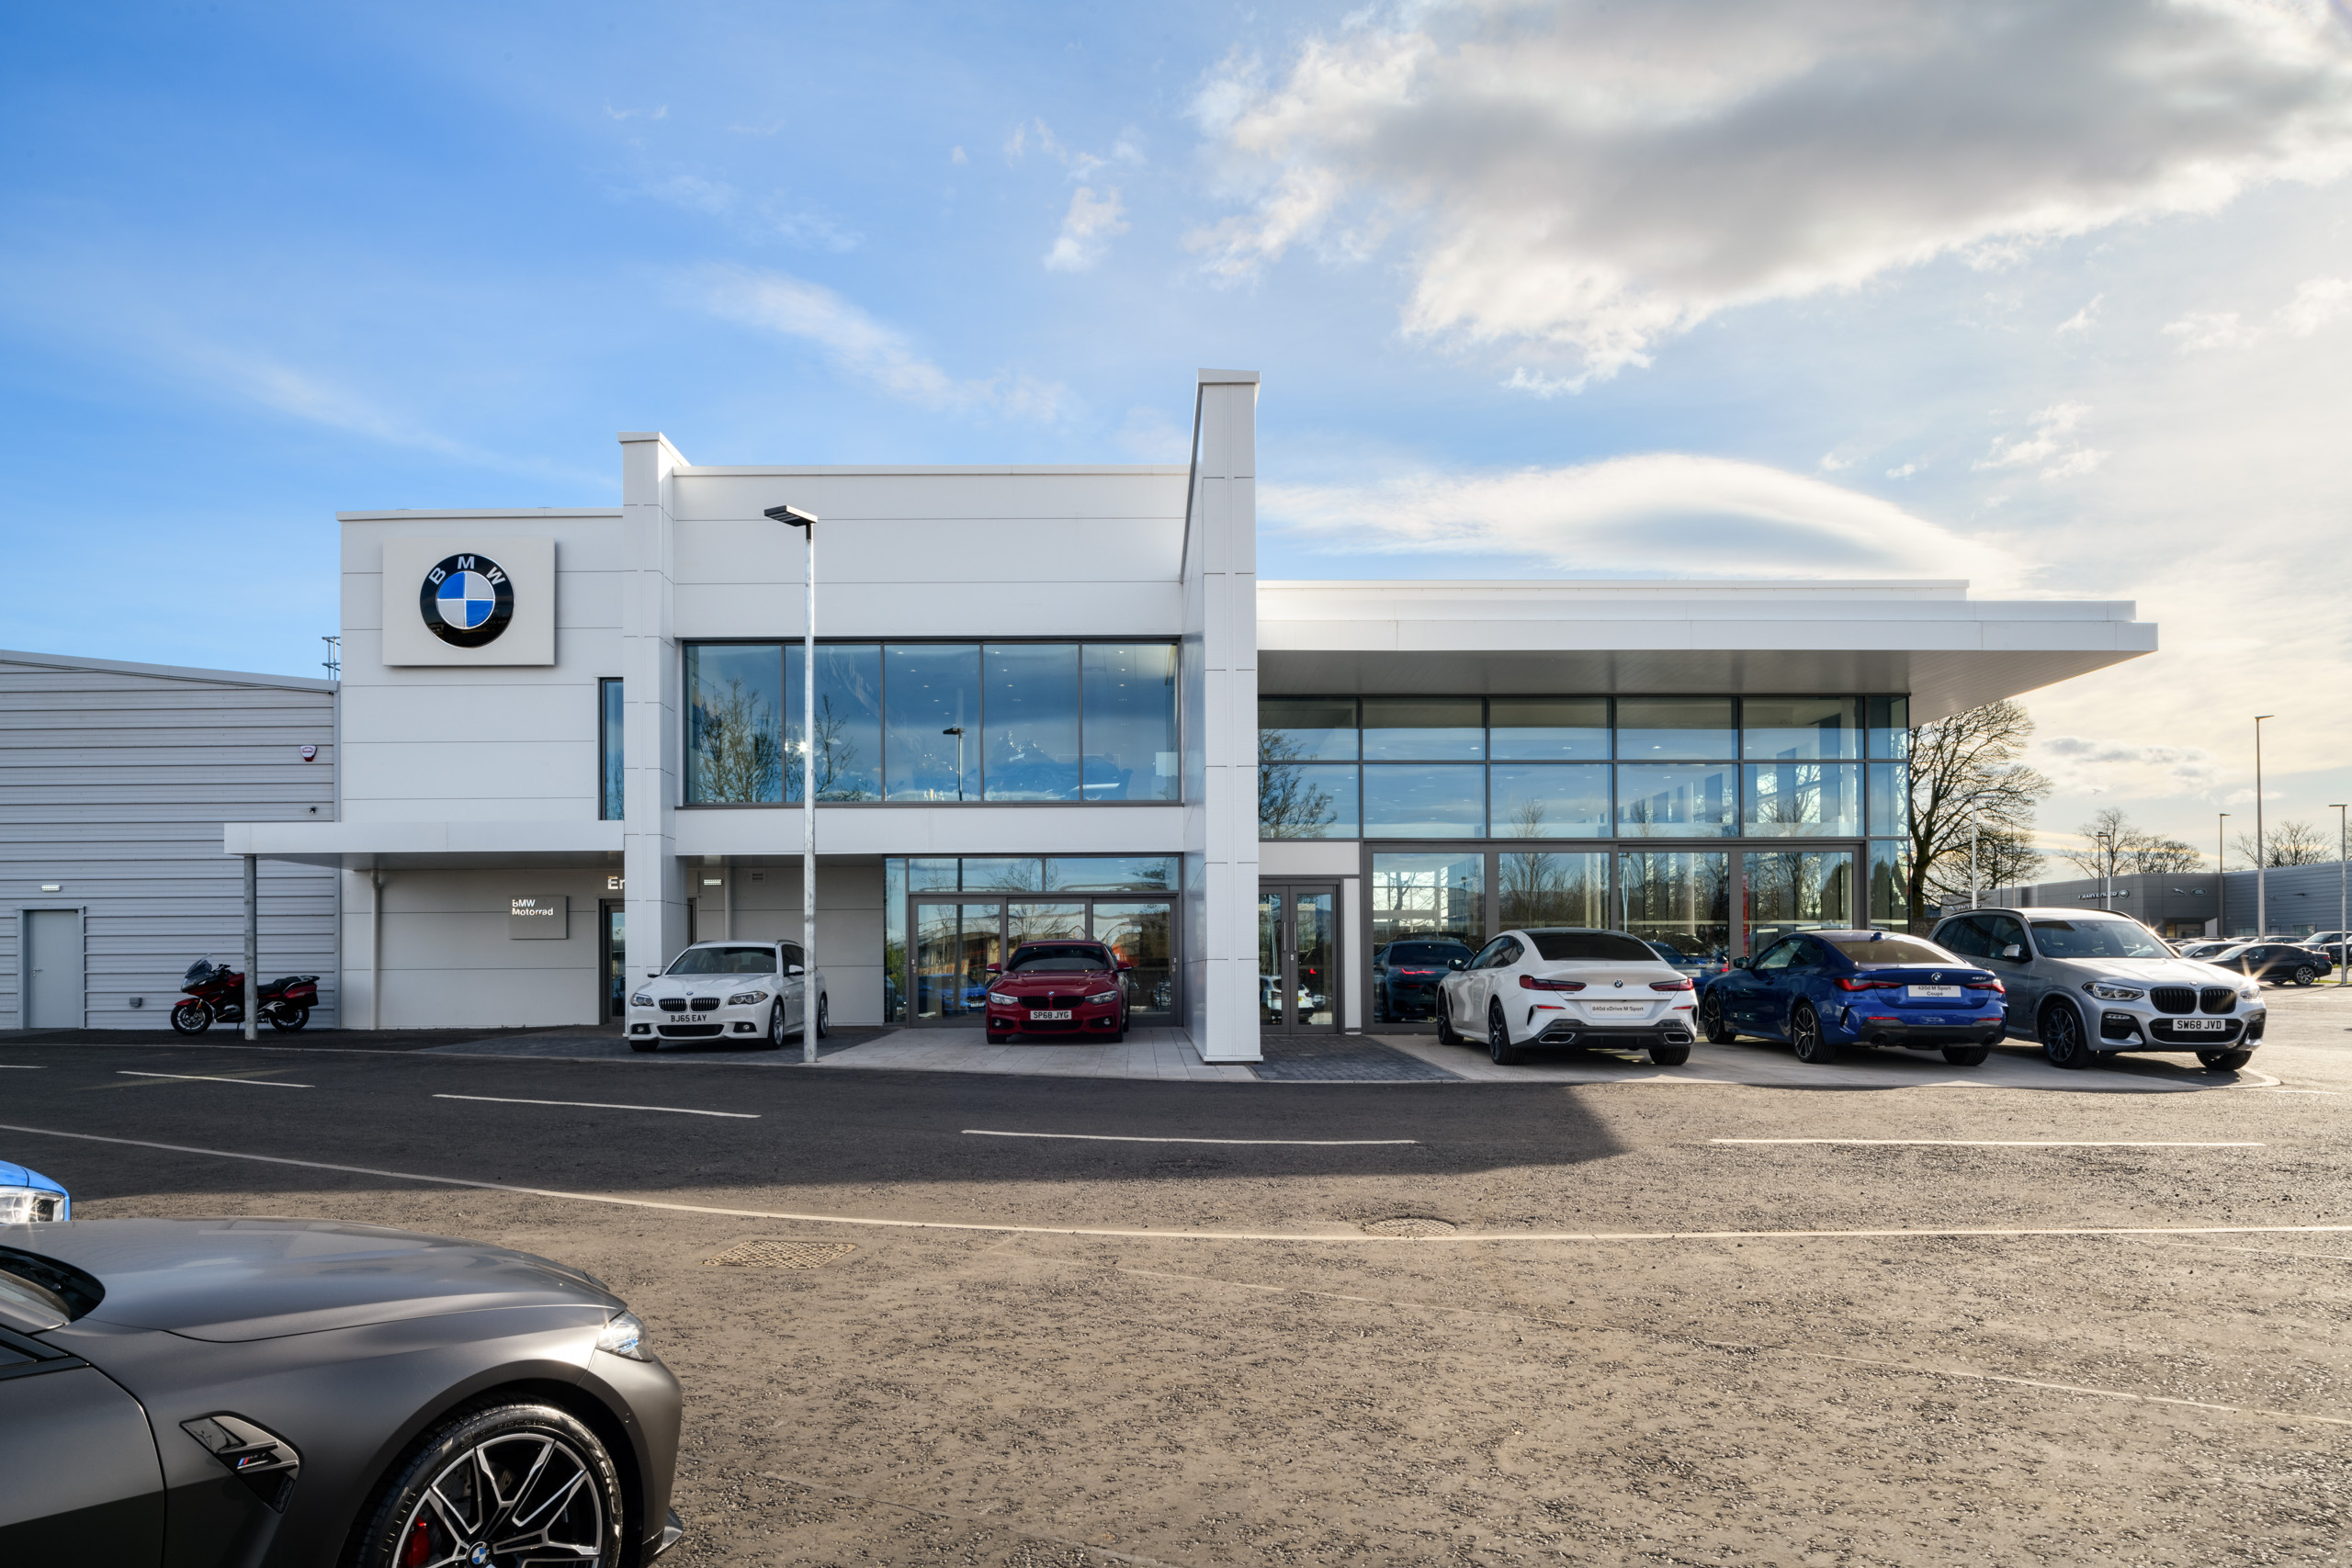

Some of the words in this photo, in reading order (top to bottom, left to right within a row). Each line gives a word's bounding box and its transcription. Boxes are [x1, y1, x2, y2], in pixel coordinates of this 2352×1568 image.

[428, 556, 506, 585] BMW
[512, 899, 536, 908] BMW
[512, 908, 554, 916] Motorrad
[2177, 1021, 2201, 1029] SW68
[2204, 1021, 2222, 1029] JVD
